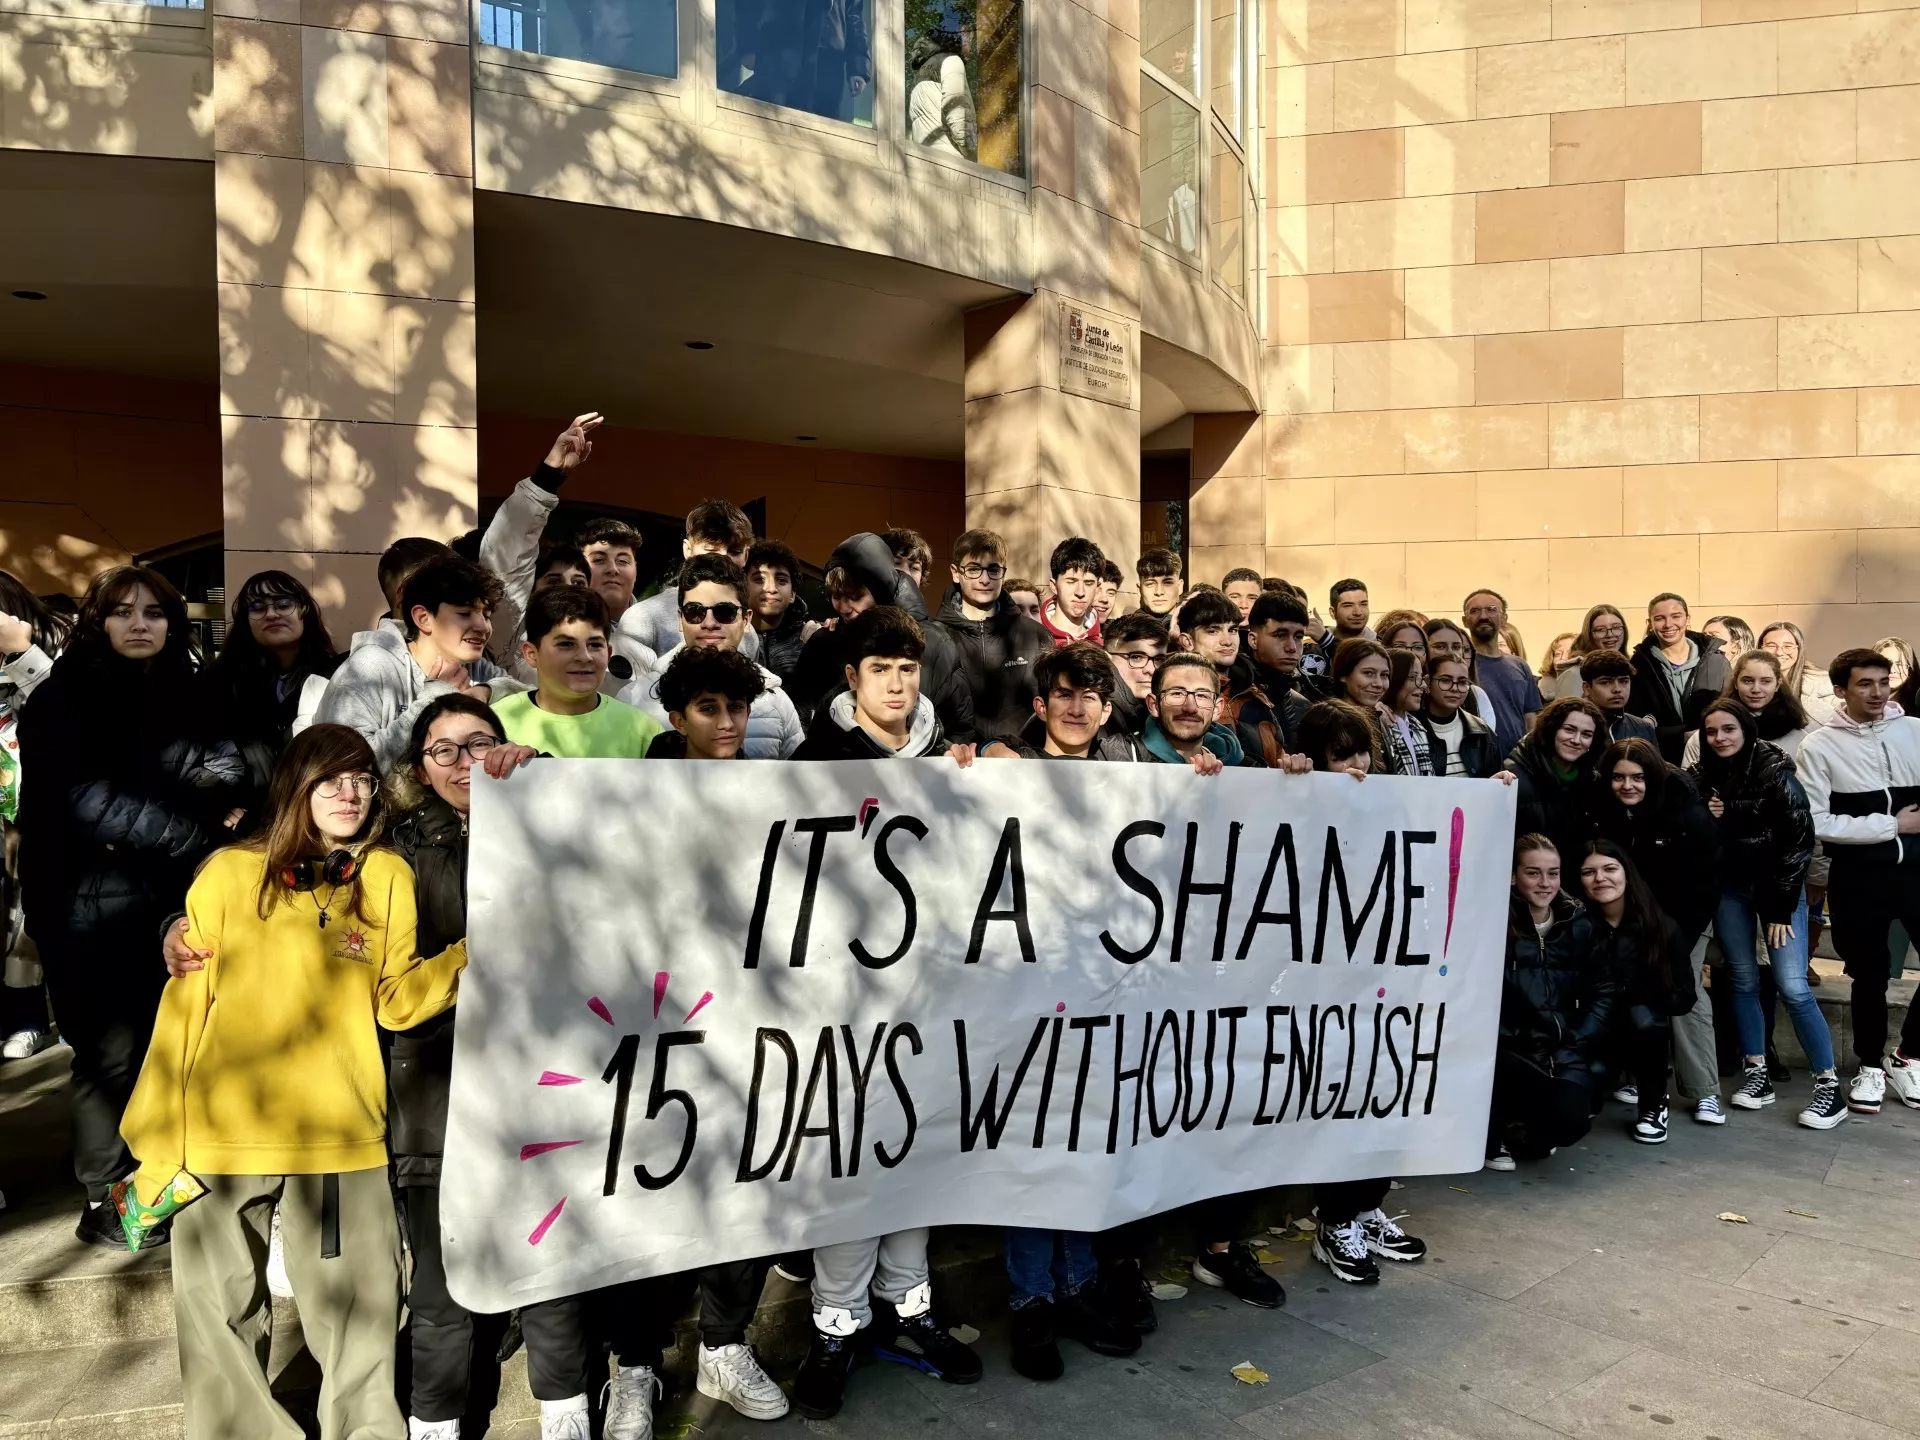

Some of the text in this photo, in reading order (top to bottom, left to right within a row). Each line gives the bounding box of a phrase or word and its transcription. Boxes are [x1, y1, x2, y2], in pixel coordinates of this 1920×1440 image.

[1085, 334, 1124, 353] Castilla y León
[1086, 323, 1110, 338] Junta de
[743, 798, 1464, 976] IT'S A SHAME!
[601, 1030, 706, 1196] 15
[735, 1022, 923, 1183] DAYS
